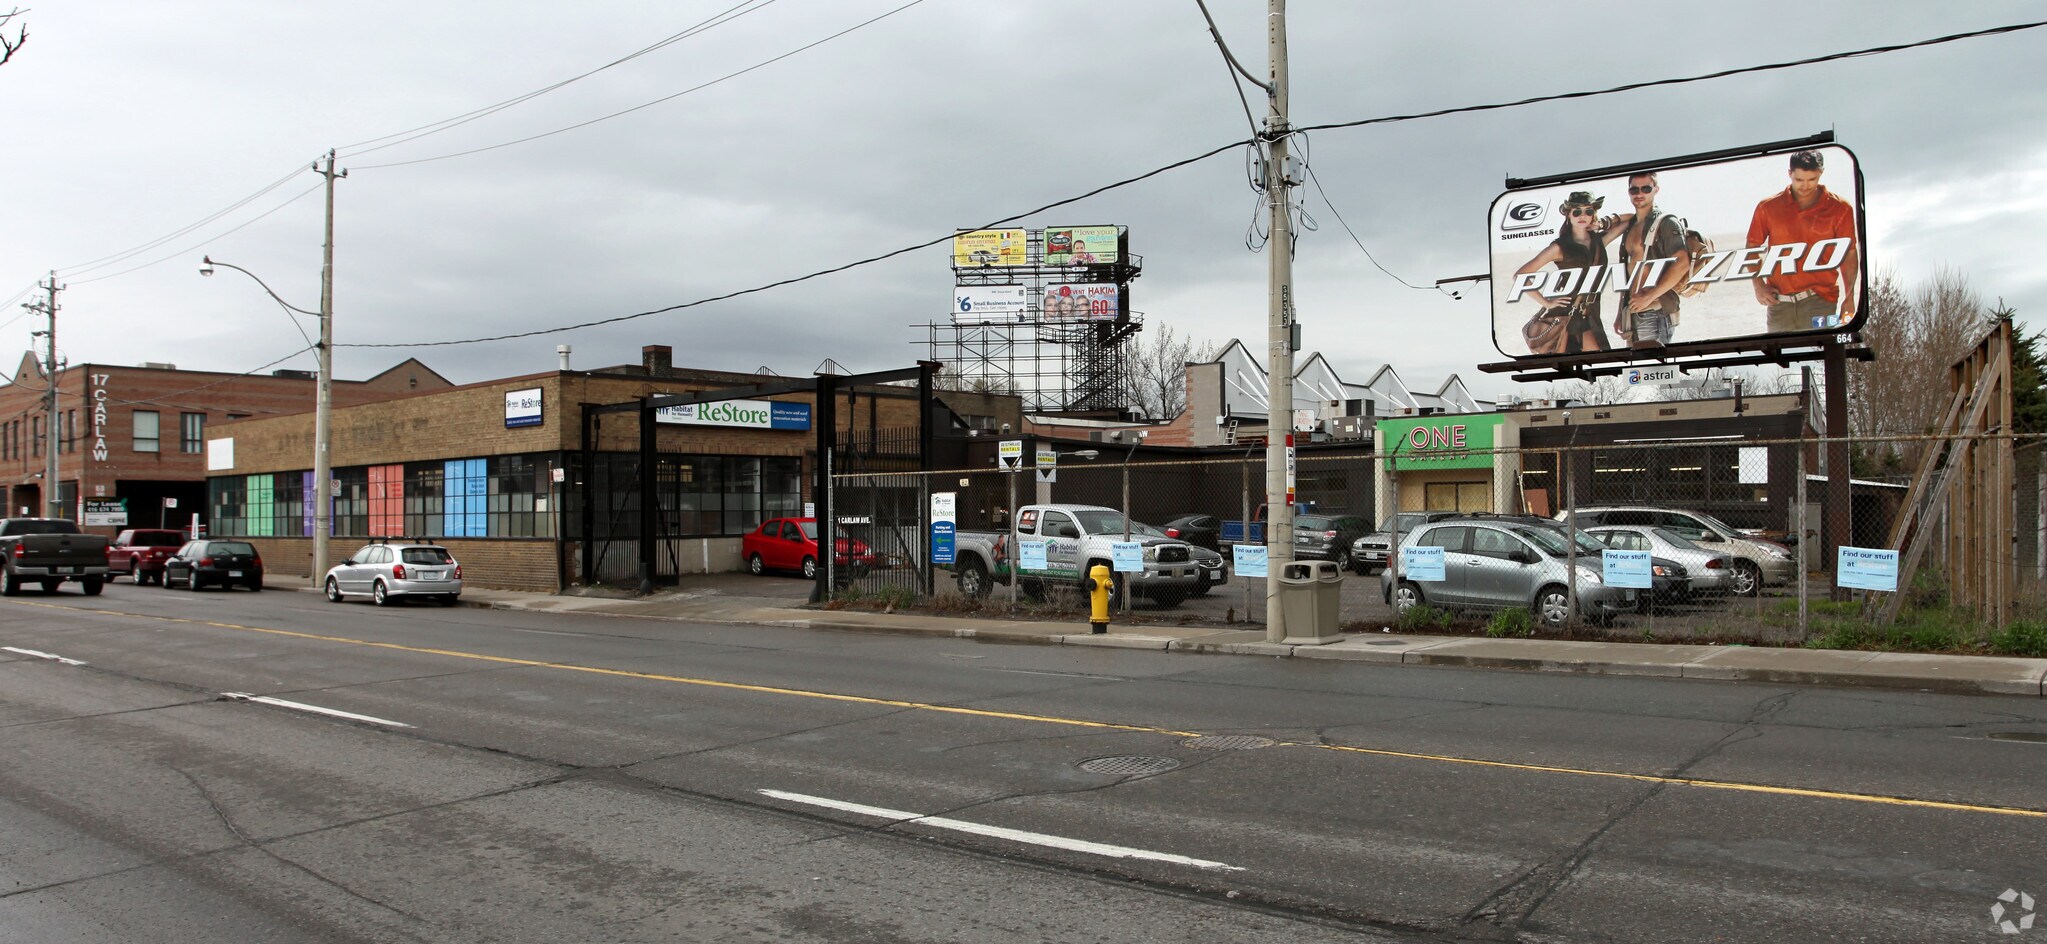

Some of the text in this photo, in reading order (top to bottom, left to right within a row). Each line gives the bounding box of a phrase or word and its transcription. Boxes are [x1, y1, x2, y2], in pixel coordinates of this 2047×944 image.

[1501, 229, 1554, 240] SUNGLASSES
[1506, 238, 1852, 302] POINT ZERO
[957, 296, 972, 311] $6
[1092, 300, 1108, 314] 60
[1836, 333, 1852, 343] 664
[1644, 370, 1673, 380] astral
[522, 398, 541, 408] ReStore
[91, 374, 109, 461] 17 CARLAW
[697, 402, 768, 423] ReStore
[1410, 424, 1466, 449] ONE
